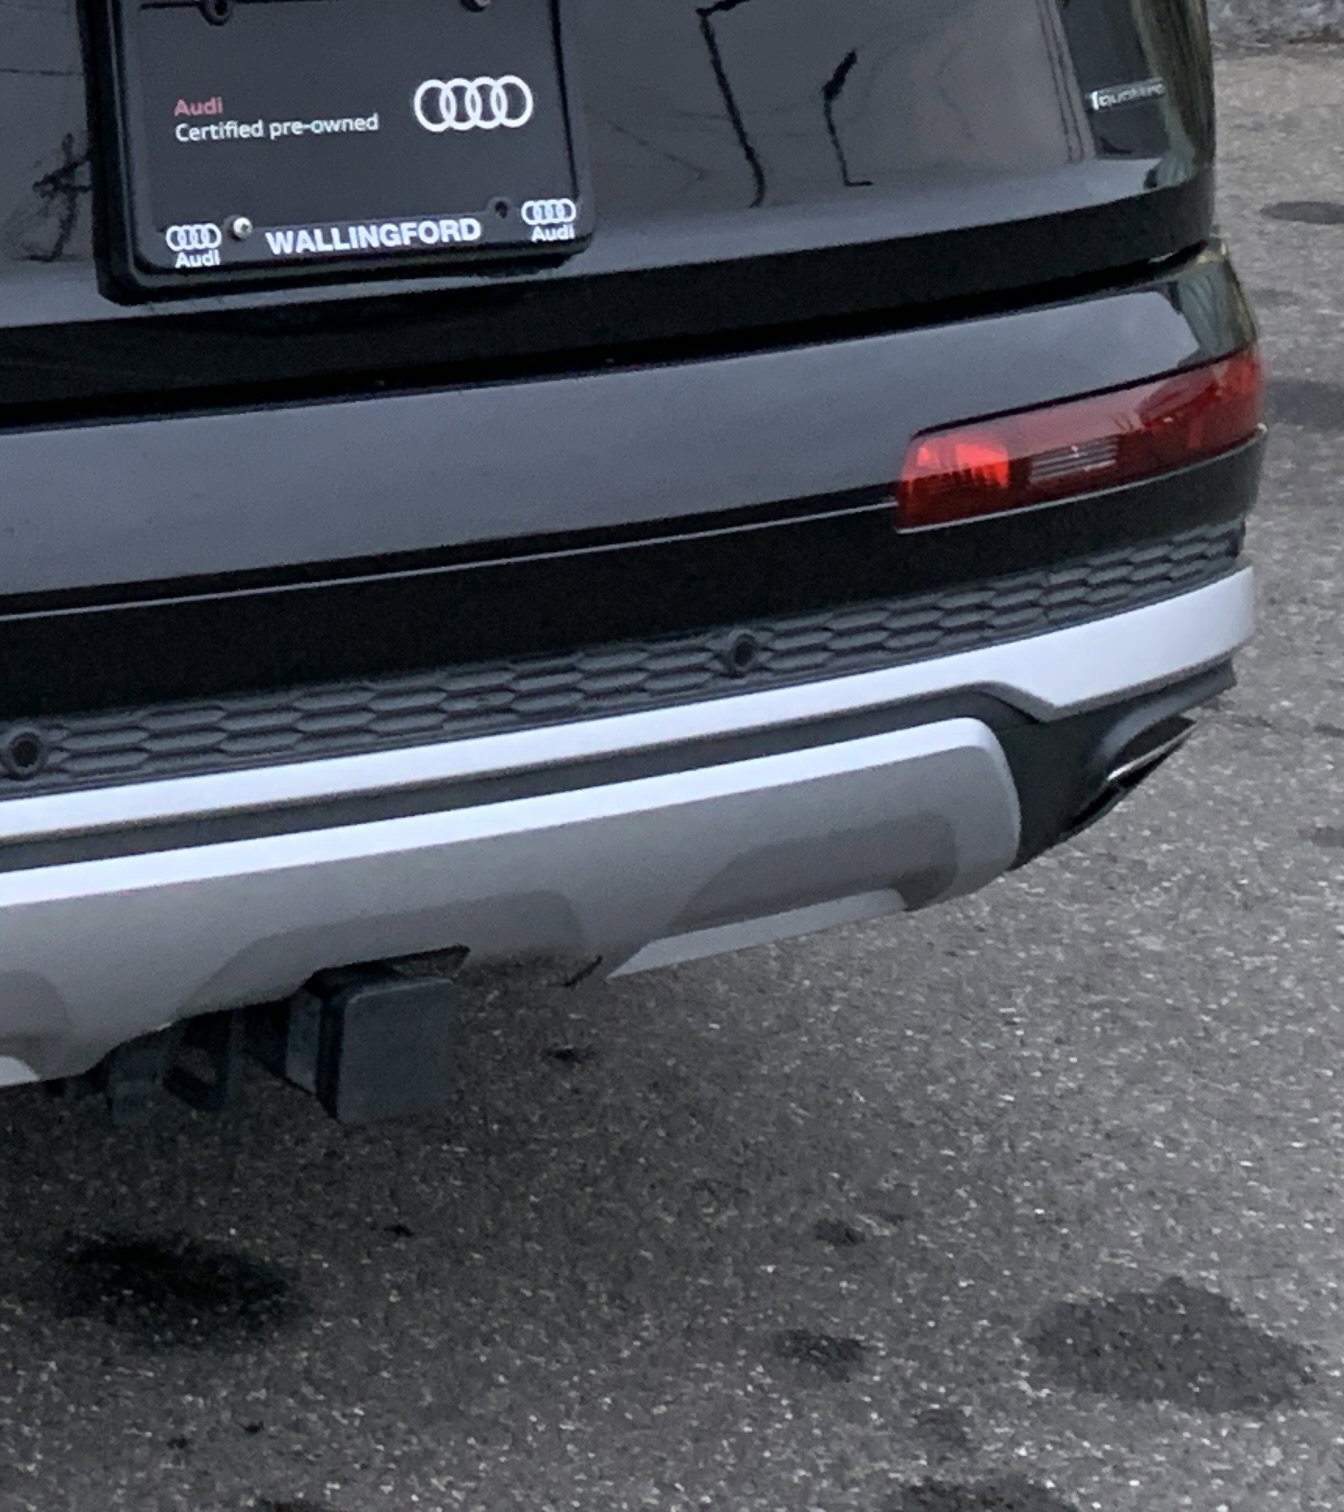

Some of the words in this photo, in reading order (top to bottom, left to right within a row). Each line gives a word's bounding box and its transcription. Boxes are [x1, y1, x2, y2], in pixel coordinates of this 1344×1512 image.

[173, 97, 223, 117] Audi
[174, 119, 264, 143] Certified
[269, 113, 380, 140] pre-owned
[265, 217, 482, 256] WALLINGFORD
[530, 224, 575, 243] Audi
[175, 249, 221, 270] Audi
